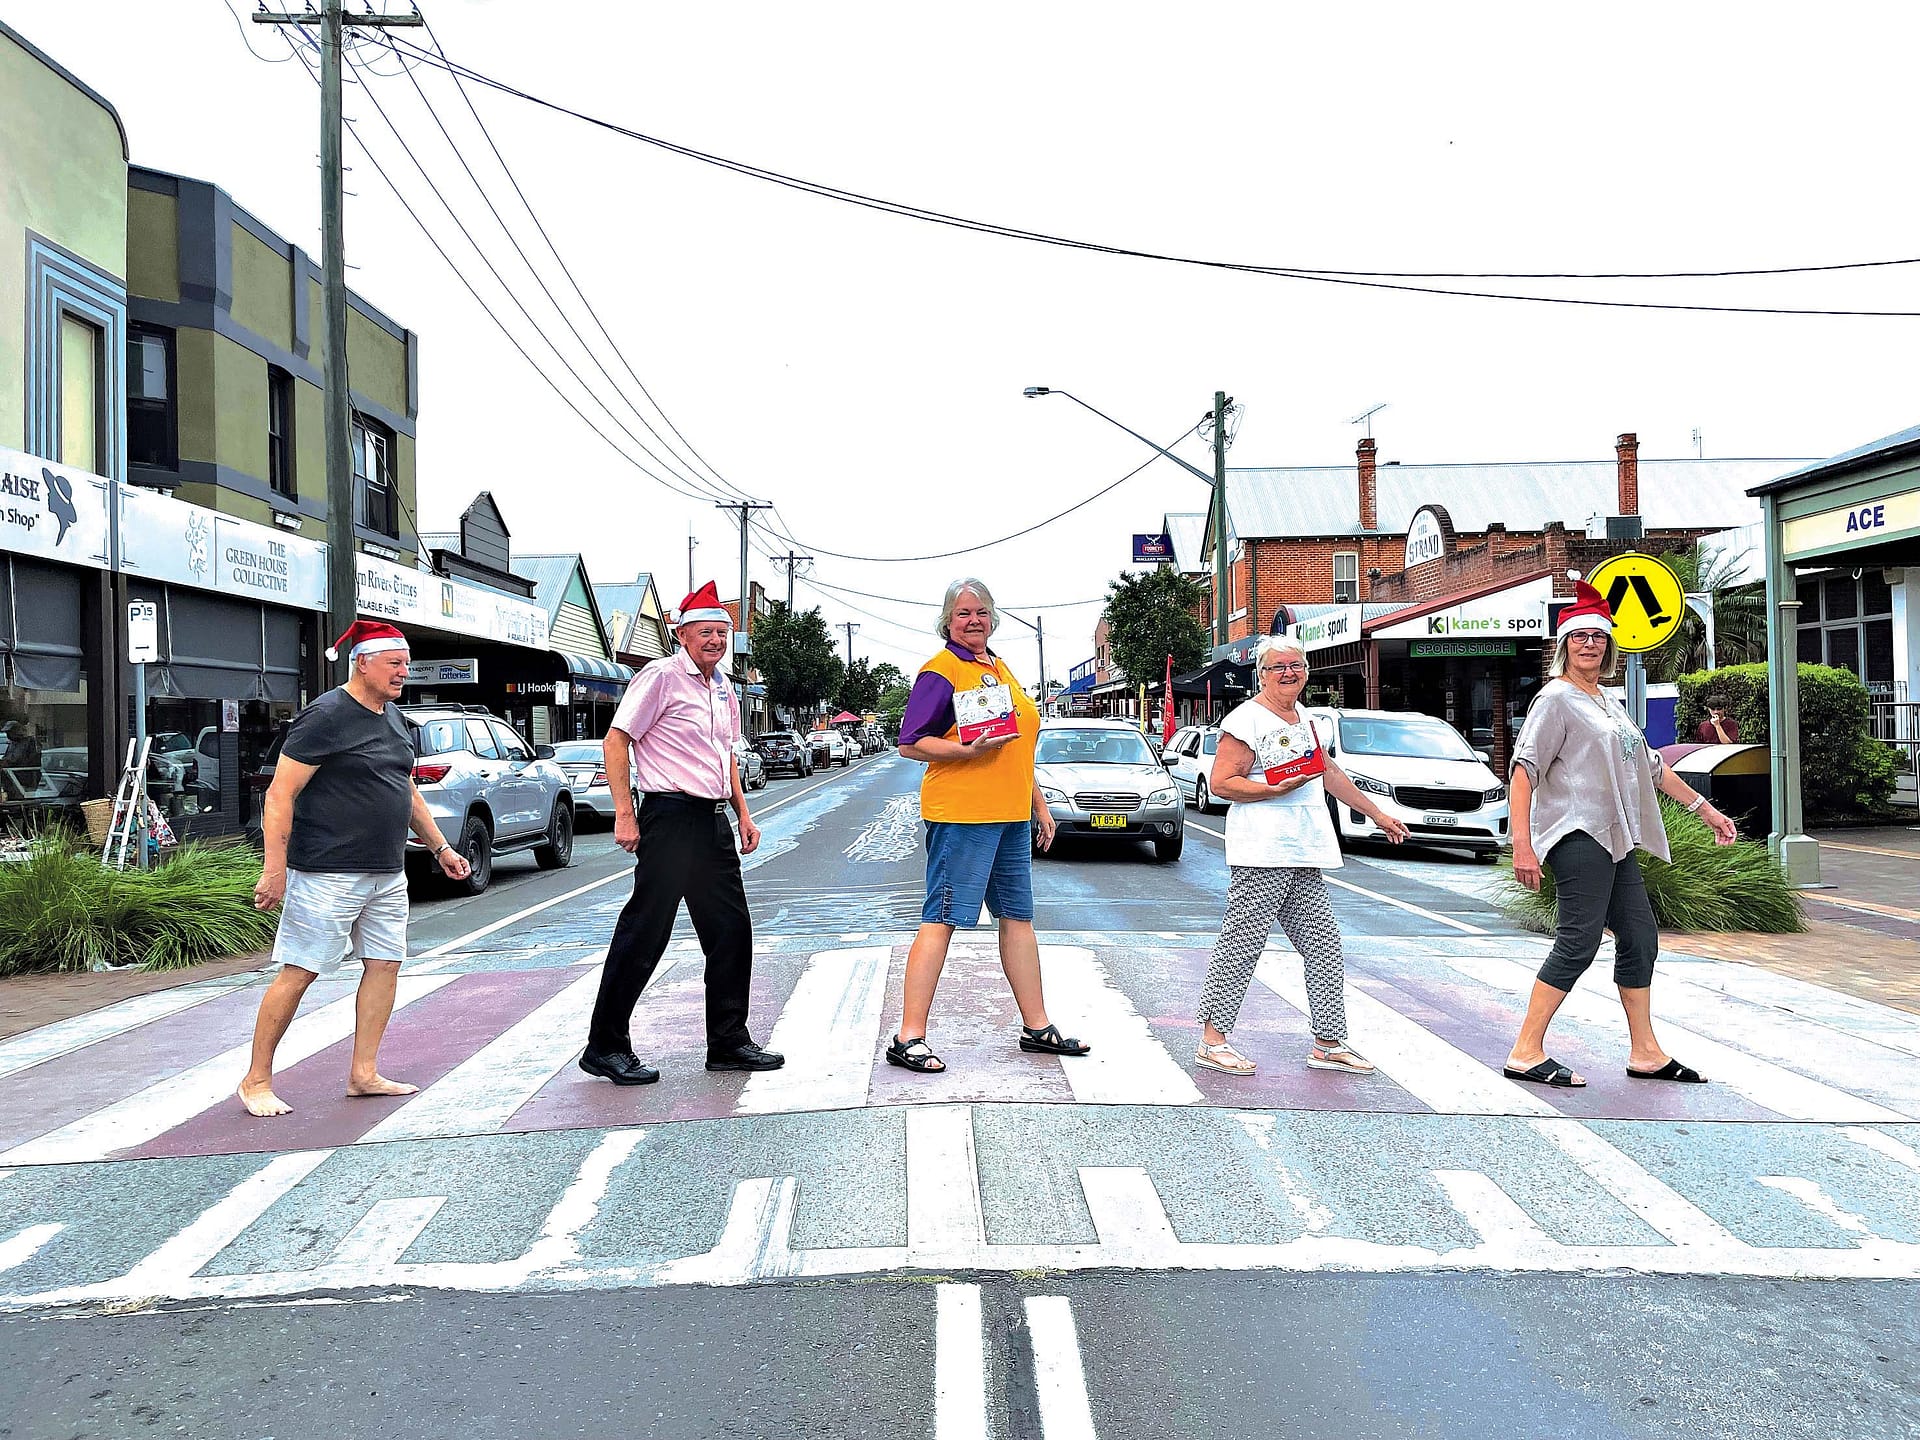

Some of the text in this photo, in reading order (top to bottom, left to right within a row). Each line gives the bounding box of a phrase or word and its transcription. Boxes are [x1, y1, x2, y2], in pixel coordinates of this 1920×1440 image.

[8, 508, 40, 531] Shop"
[1846, 505, 1884, 532] ACE
[268, 540, 286, 558] THE
[1409, 534, 1438, 563] STRAND
[226, 547, 287, 576] GREEN HOUSE
[233, 568, 287, 592] COLLECTIVE
[368, 569, 392, 592] Rivers
[394, 574, 417, 598] Times
[130, 607, 141, 621] P
[357, 598, 383, 613] AILABLE
[384, 603, 400, 616] HERE
[1304, 620, 1326, 641] kane's
[1328, 612, 1348, 641] sport
[1452, 617, 1501, 630] kane's
[1508, 618, 1542, 632] spor
[1416, 641, 1511, 655] SPORTS STORE
[440, 671, 471, 680] Lotteries
[517, 682, 557, 695] LJ Hook
